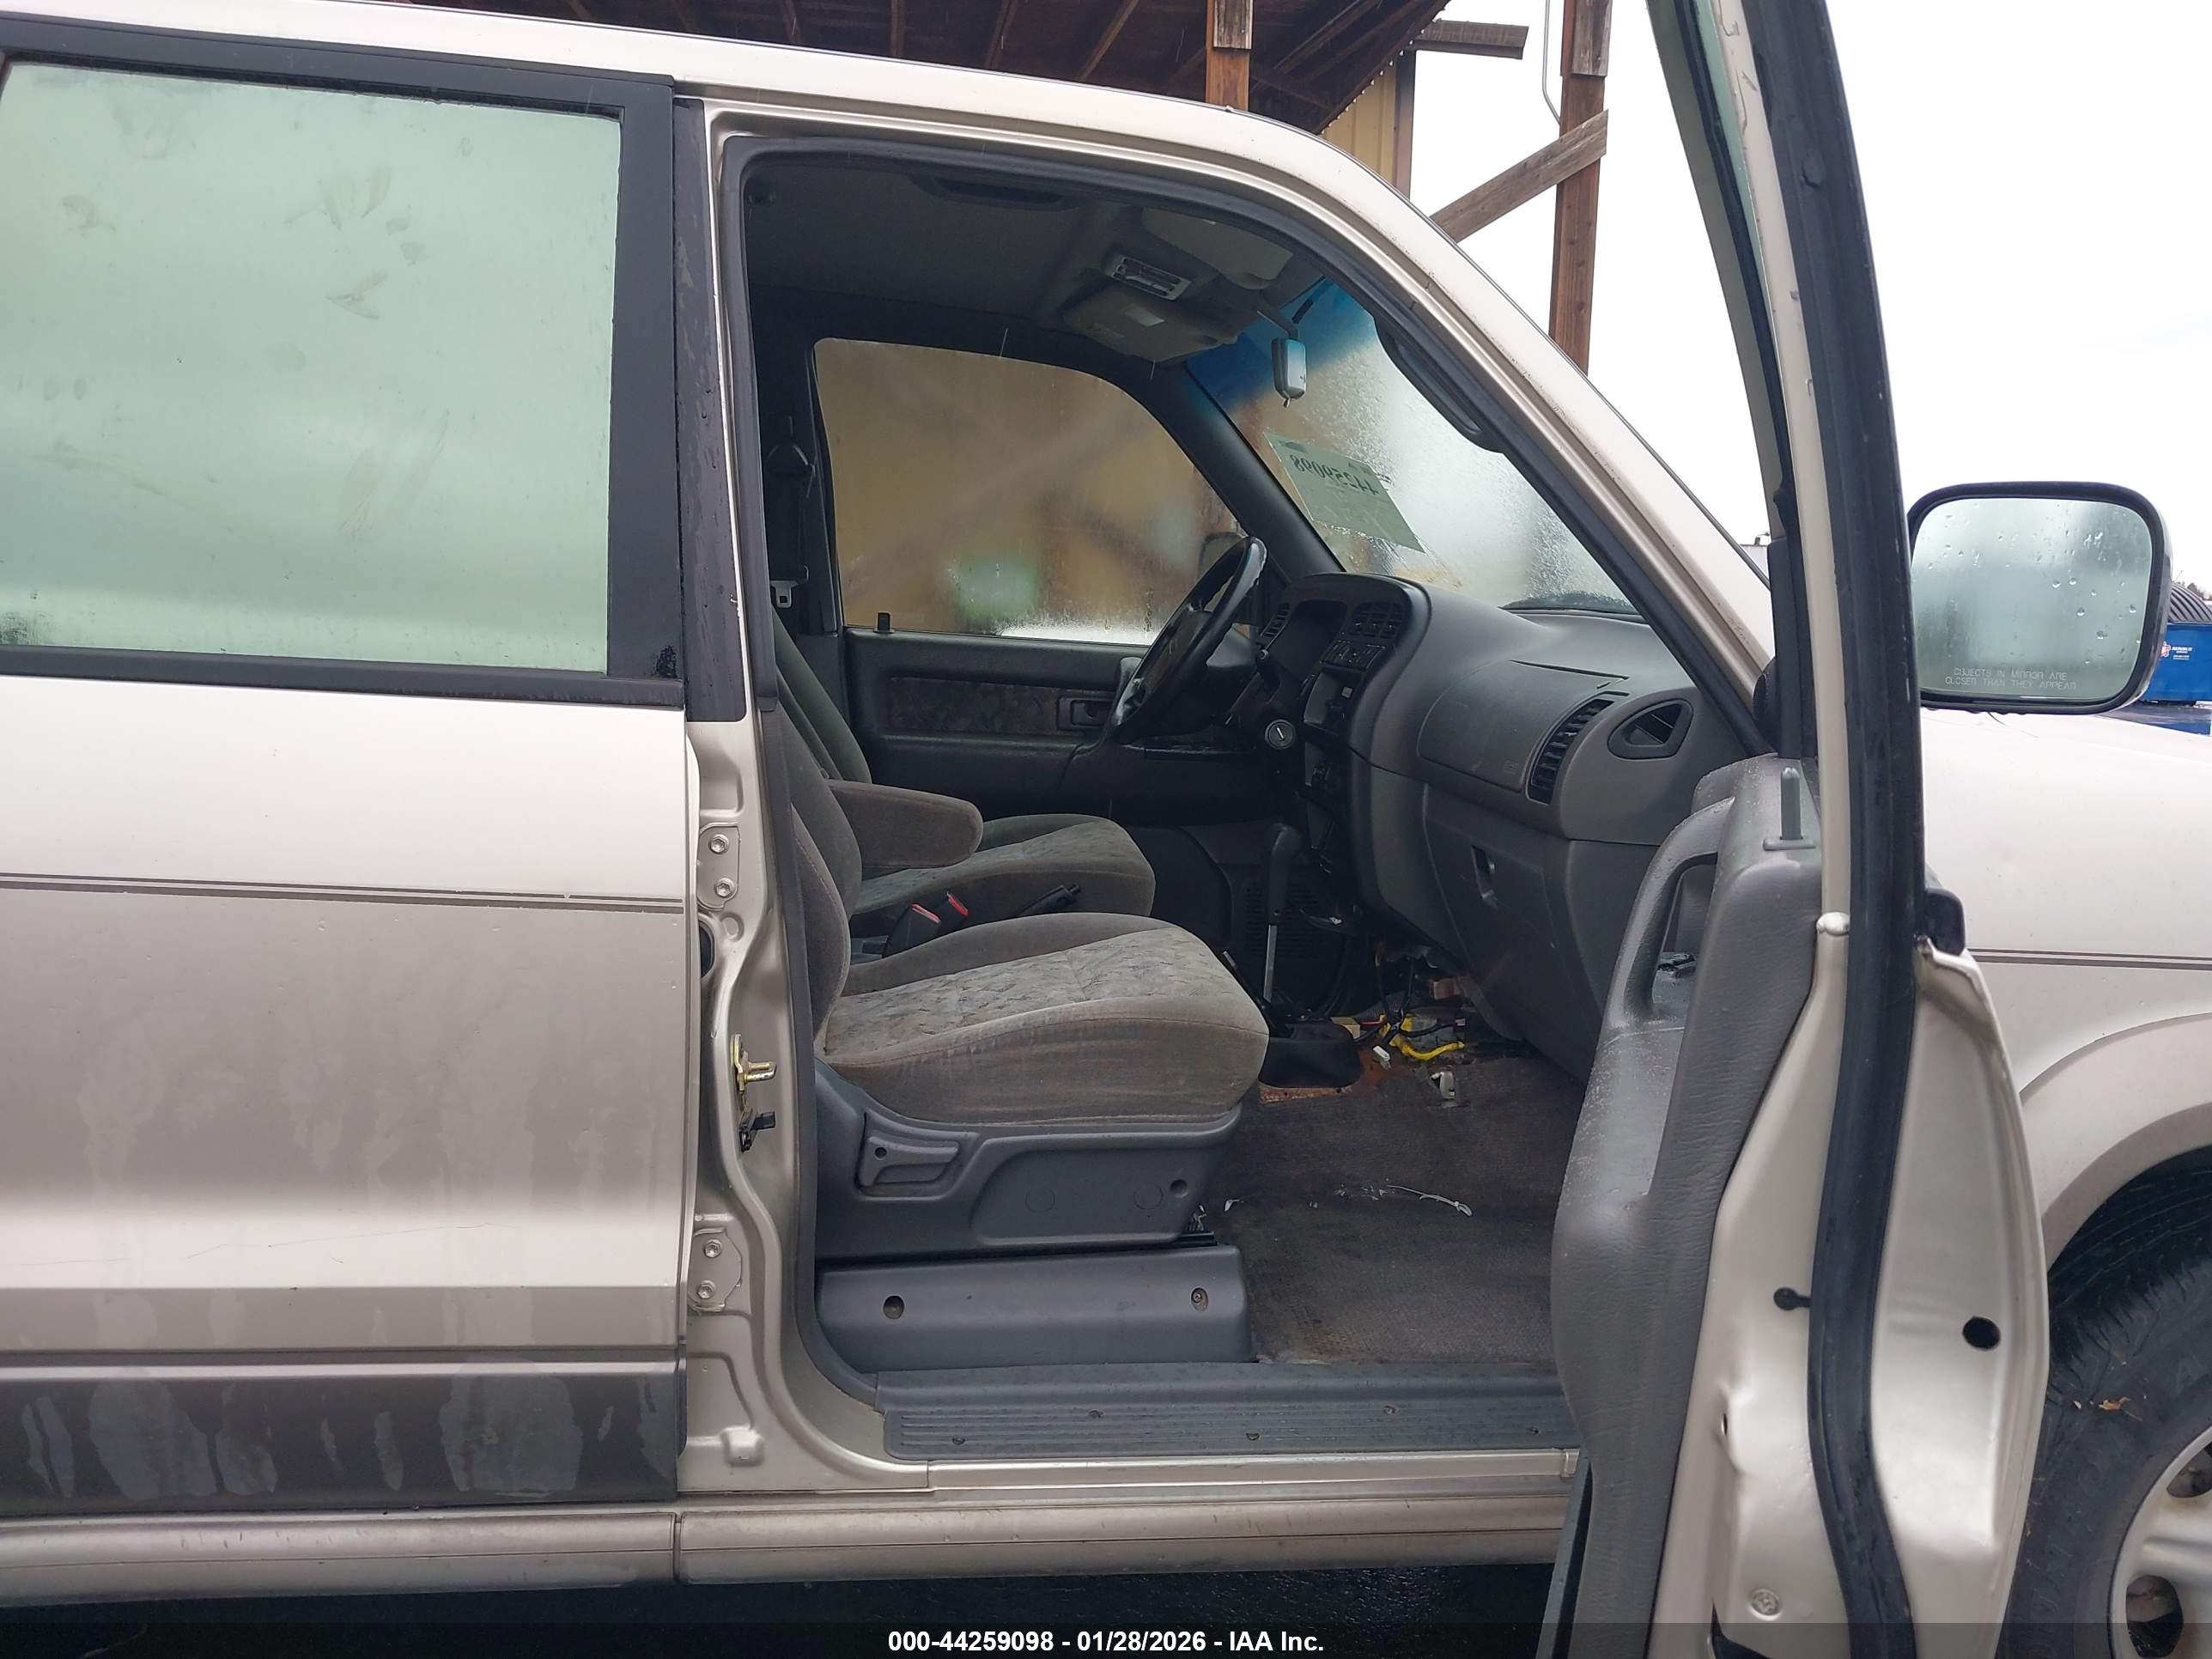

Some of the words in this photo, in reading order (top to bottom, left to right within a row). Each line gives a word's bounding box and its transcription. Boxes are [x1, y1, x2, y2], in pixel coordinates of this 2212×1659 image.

[1997, 668, 2006, 678] IN
[2049, 672, 2068, 681] ARE
[1983, 678, 2006, 688] THAN
[2012, 679, 2034, 689] THEY
